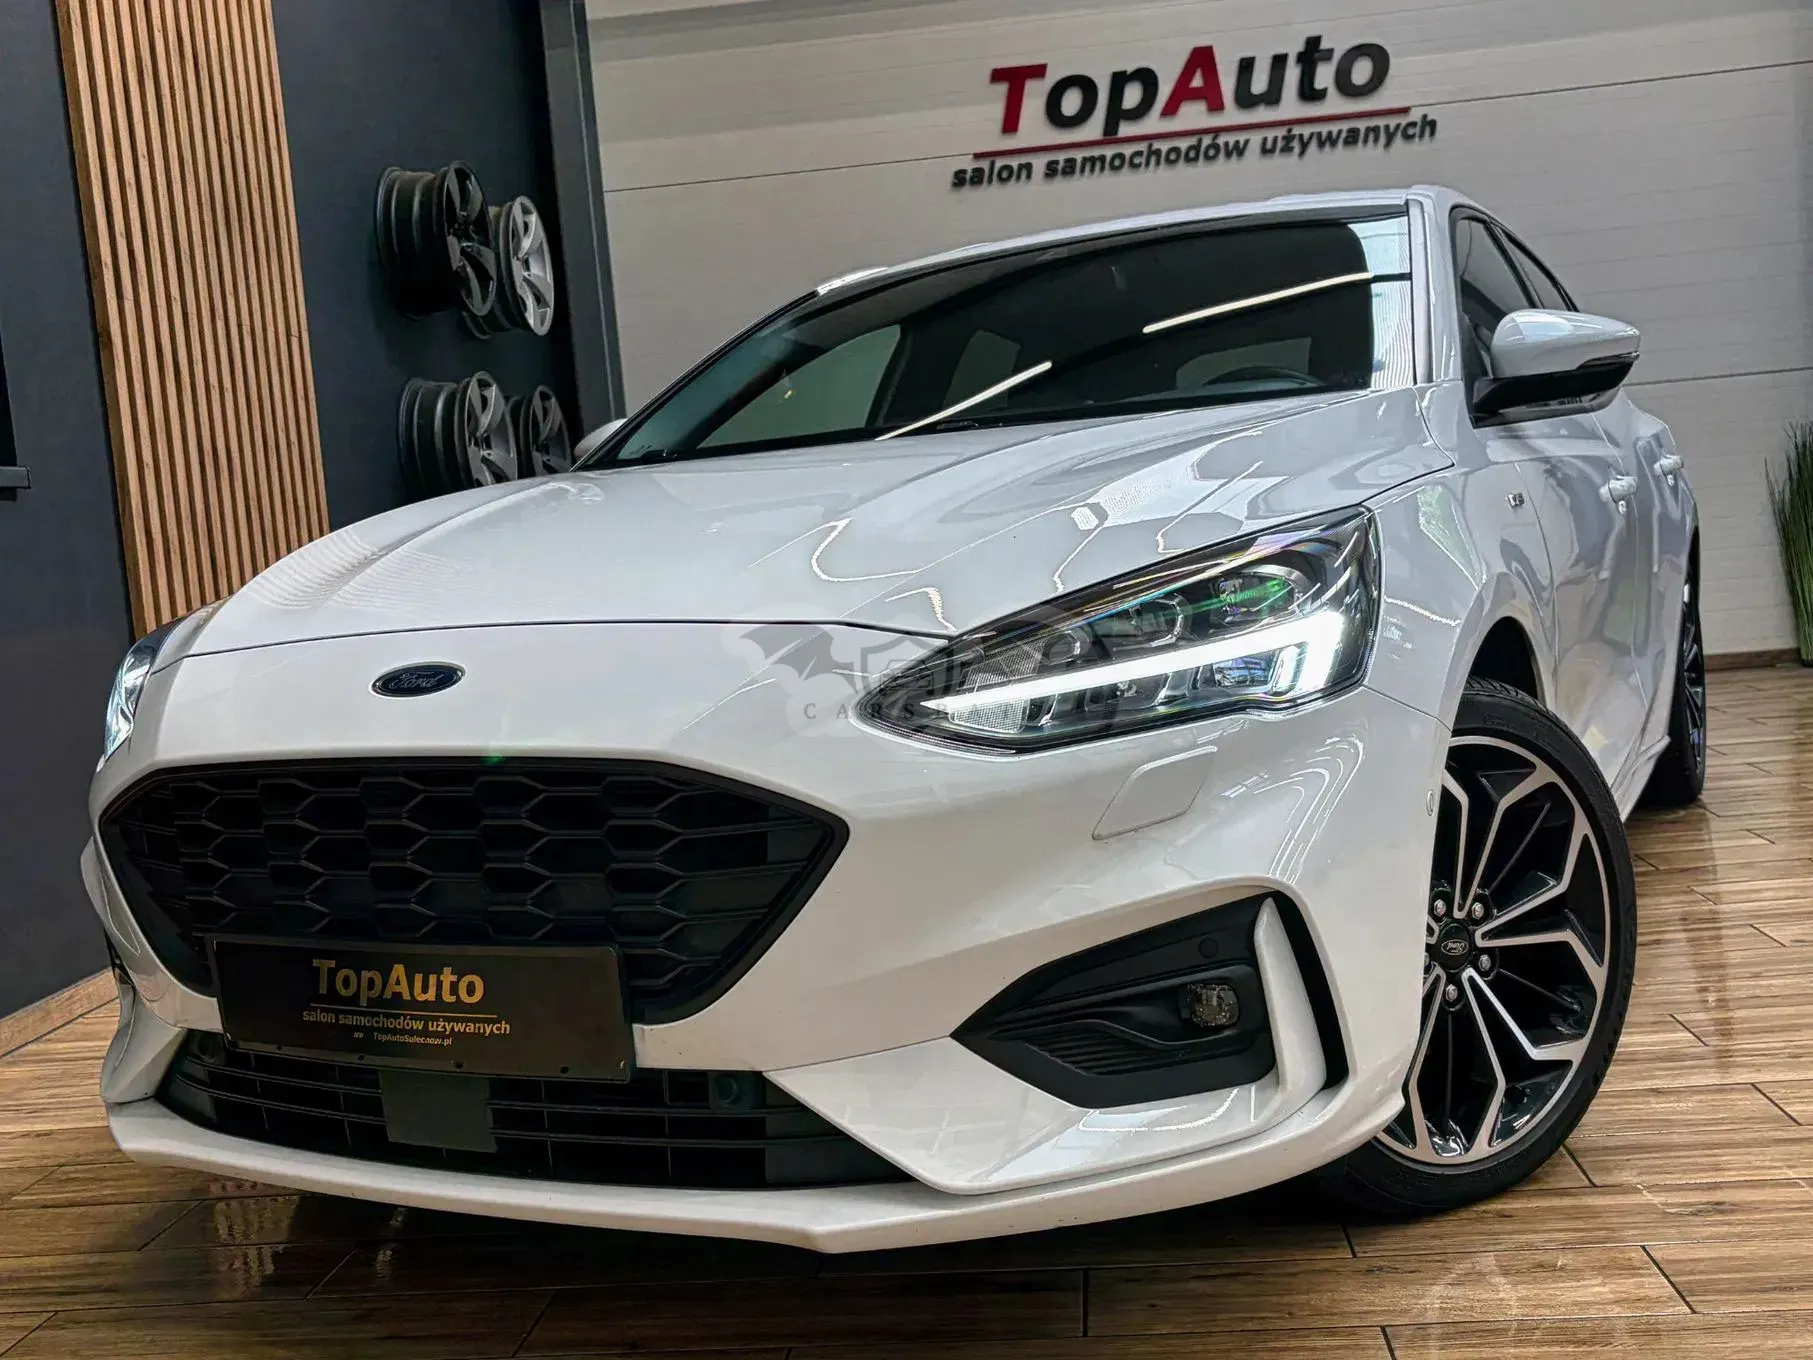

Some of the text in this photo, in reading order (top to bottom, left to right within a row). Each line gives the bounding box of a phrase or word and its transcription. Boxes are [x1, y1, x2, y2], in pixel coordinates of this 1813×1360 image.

[989, 35, 1392, 137] TopAuto
[951, 115, 1438, 189] salon samochodów używanych
[388, 671, 445, 689] Ford
[312, 959, 484, 1006] TopAuto
[302, 1009, 510, 1036] salon samochodów używanych
